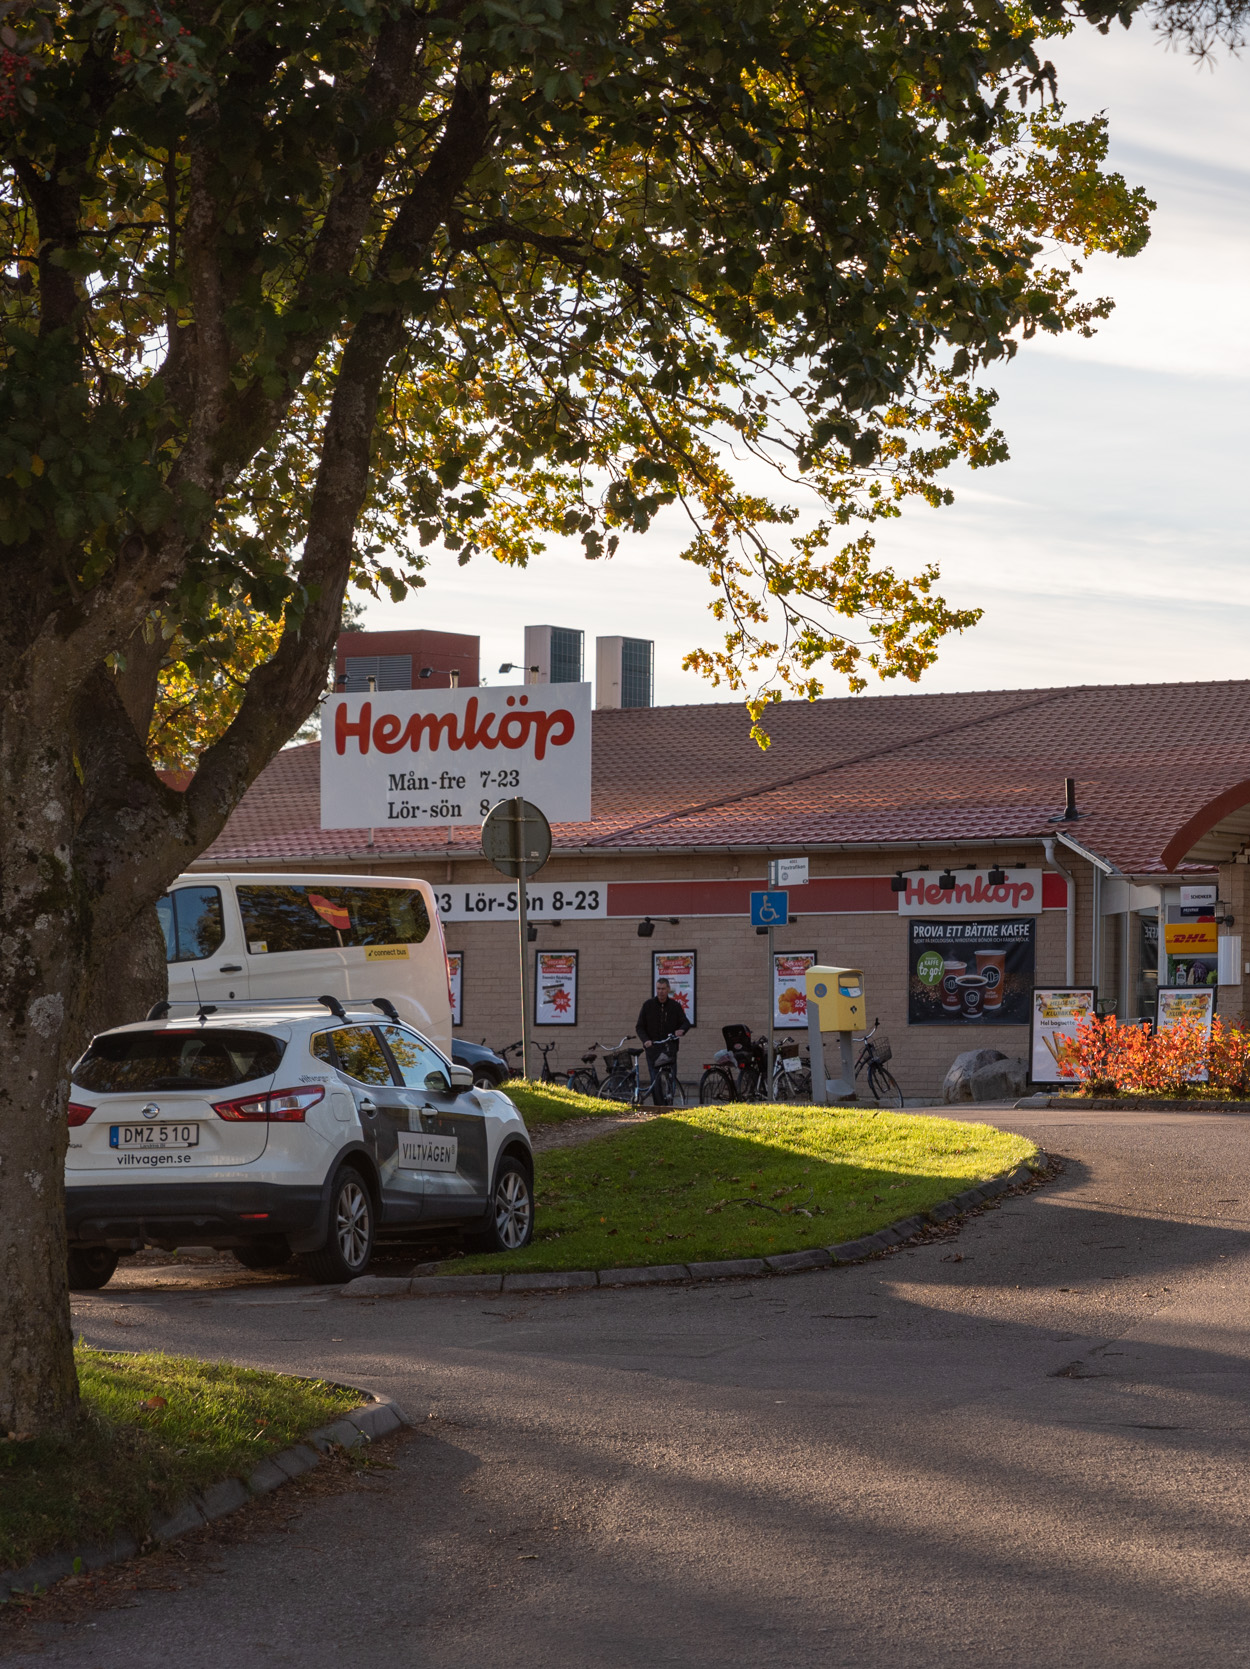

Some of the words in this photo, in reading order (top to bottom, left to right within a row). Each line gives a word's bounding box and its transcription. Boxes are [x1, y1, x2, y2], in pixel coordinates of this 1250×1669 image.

[334, 695, 575, 760] Hemköp
[388, 770, 466, 792] Mån-fre
[479, 769, 520, 788] 7-23
[387, 800, 462, 819] Lör-sön
[552, 890, 600, 911] 8-23
[904, 875, 1035, 909] Hemköp
[913, 925, 943, 938] PROVA
[946, 925, 963, 937] ETT
[965, 922, 998, 937] BÄTTRE
[1001, 924, 1030, 937] KAFFE
[1173, 933, 1208, 943] DHL
[374, 949, 396, 957] connect
[396, 948, 406, 956] bus
[918, 961, 929, 976] to
[928, 961, 944, 983] go!
[794, 1000, 804, 1008] 25
[124, 1127, 154, 1143] DMZ
[159, 1126, 190, 1142] 510
[117, 1153, 192, 1167] viltvagen.se
[402, 1141, 451, 1163] VILTVÄGEN
